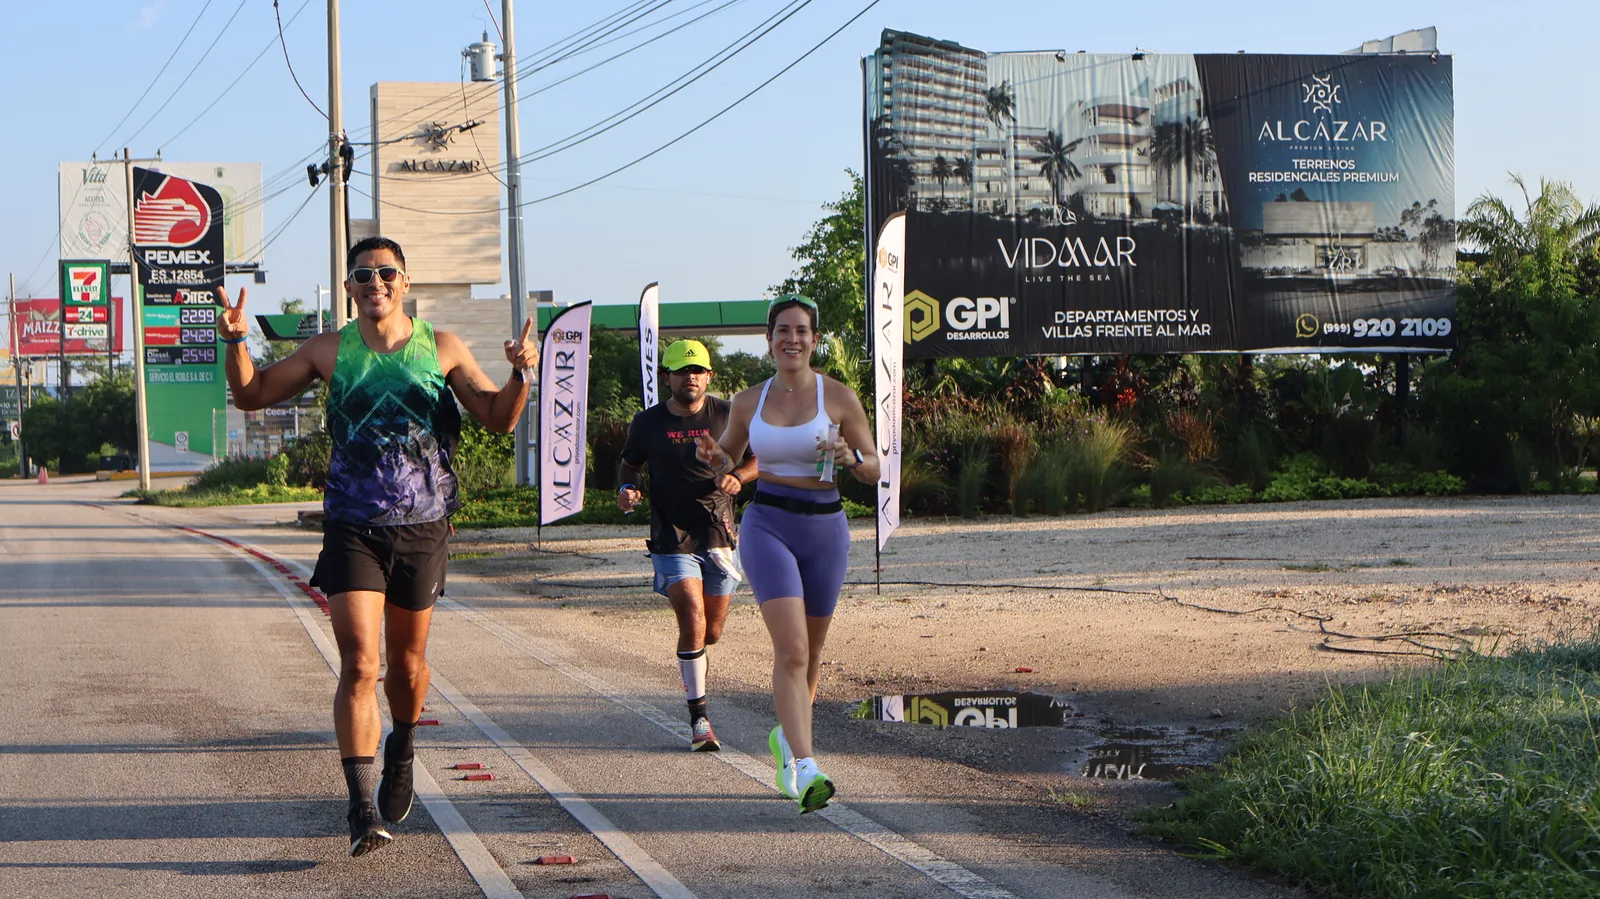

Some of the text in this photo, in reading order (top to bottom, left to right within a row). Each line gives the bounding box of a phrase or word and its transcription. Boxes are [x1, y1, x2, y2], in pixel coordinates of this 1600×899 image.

[1292, 159, 1355, 170] TERRENOS
[81, 166, 107, 185] Vita
[1249, 172, 1399, 183] RESIDENCIALES PREMIUM
[145, 250, 214, 264] PEMEX
[997, 236, 1137, 269] VIDMAR
[151, 269, 204, 280] ES 12654
[1025, 275, 1052, 283] LIVE
[1060, 274, 1081, 282] THE
[79, 310, 93, 320] 24
[1054, 309, 1200, 323] DEPARTAMENTOS Y
[67, 326, 105, 337] 7-drive
[1042, 323, 1211, 339] VILLAS FRENTE AL MAR
[1323, 317, 1452, 337] (999) 920 2109
[946, 330, 1010, 341] DESARROLLOS
